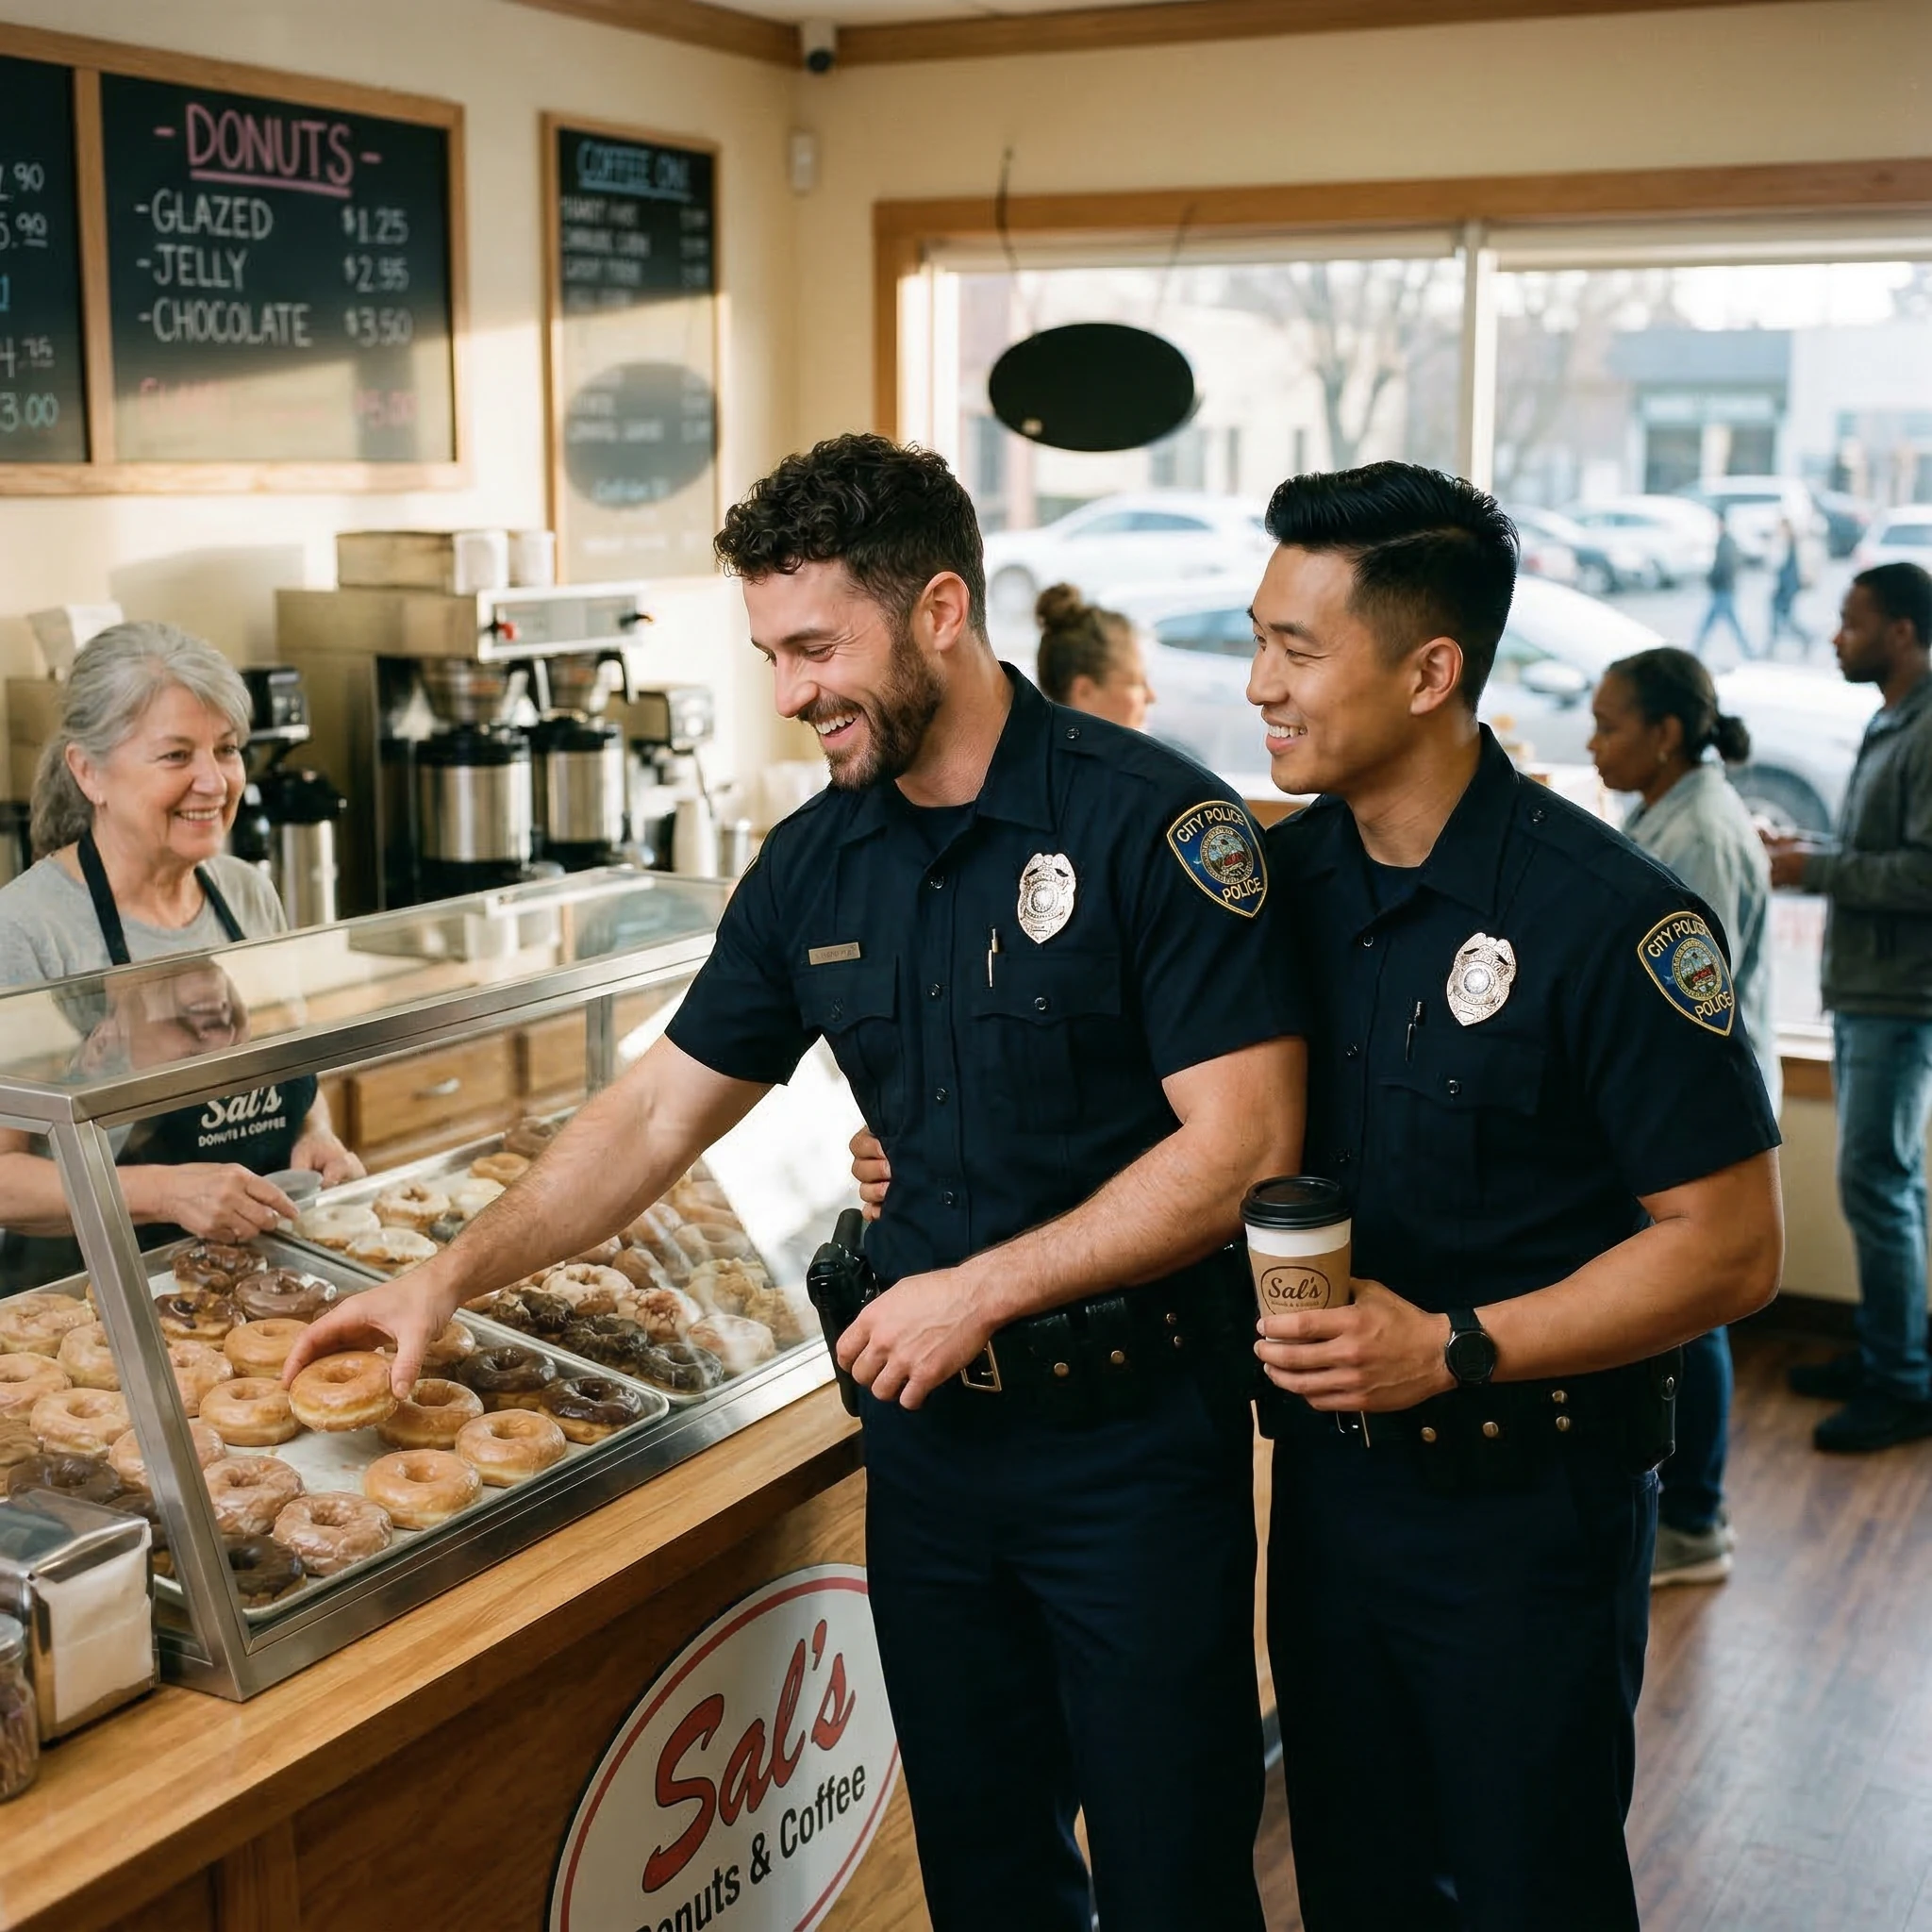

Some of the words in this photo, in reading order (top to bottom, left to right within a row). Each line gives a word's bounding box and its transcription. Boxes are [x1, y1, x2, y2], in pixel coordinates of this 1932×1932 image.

[186, 103, 354, 187] DONUTS
[1176, 813, 1205, 842] CITY
[1204, 808, 1245, 826] POLICE
[1222, 876, 1264, 903] POLICE
[1647, 926, 1674, 958] CITY
[1694, 991, 1733, 1021] POLICE
[1269, 1276, 1323, 1300] Sal's
[642, 1619, 856, 1893] Sal's
[636, 1865, 741, 1932] nuts
[750, 1831, 772, 1885] &
[779, 1764, 866, 1859] Coffee
